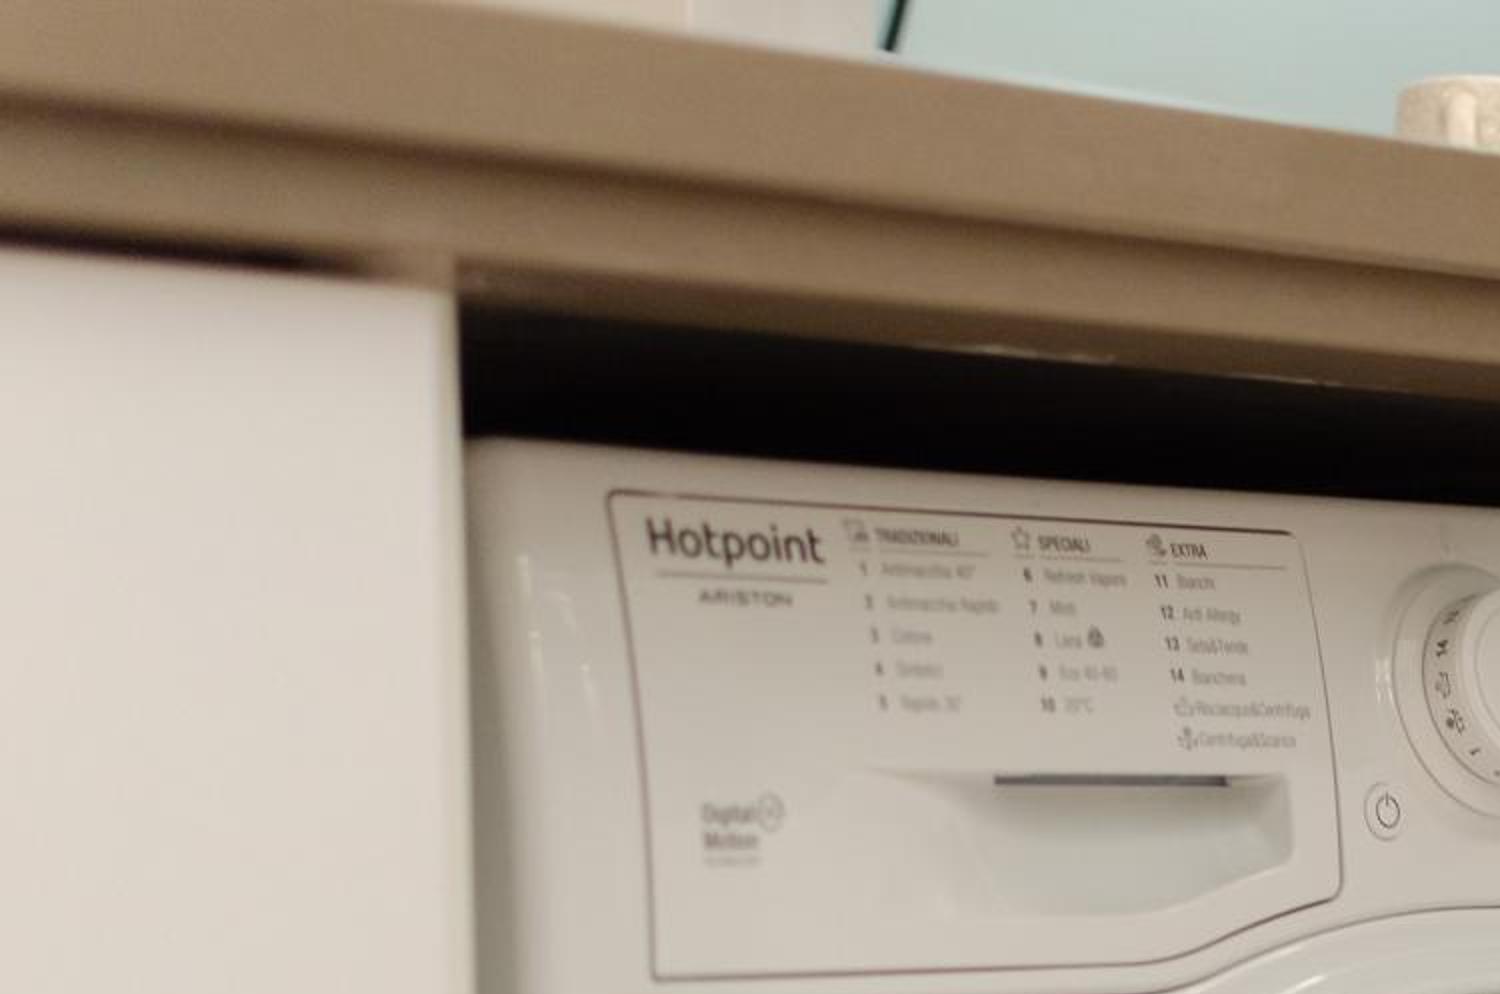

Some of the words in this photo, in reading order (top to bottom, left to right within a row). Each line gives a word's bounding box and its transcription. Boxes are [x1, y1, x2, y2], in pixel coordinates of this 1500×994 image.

[645, 516, 826, 567] Hotpoint
[873, 527, 960, 547] TRADIZIONALI
[1038, 535, 1091, 553] SPECIALI
[1169, 543, 1208, 560] EXTRA
[1153, 573, 1168, 589] 11
[698, 588, 793, 608] ARISTON
[1160, 604, 1174, 620] 12
[1164, 635, 1180, 652] 13
[1169, 667, 1185, 683] 14
